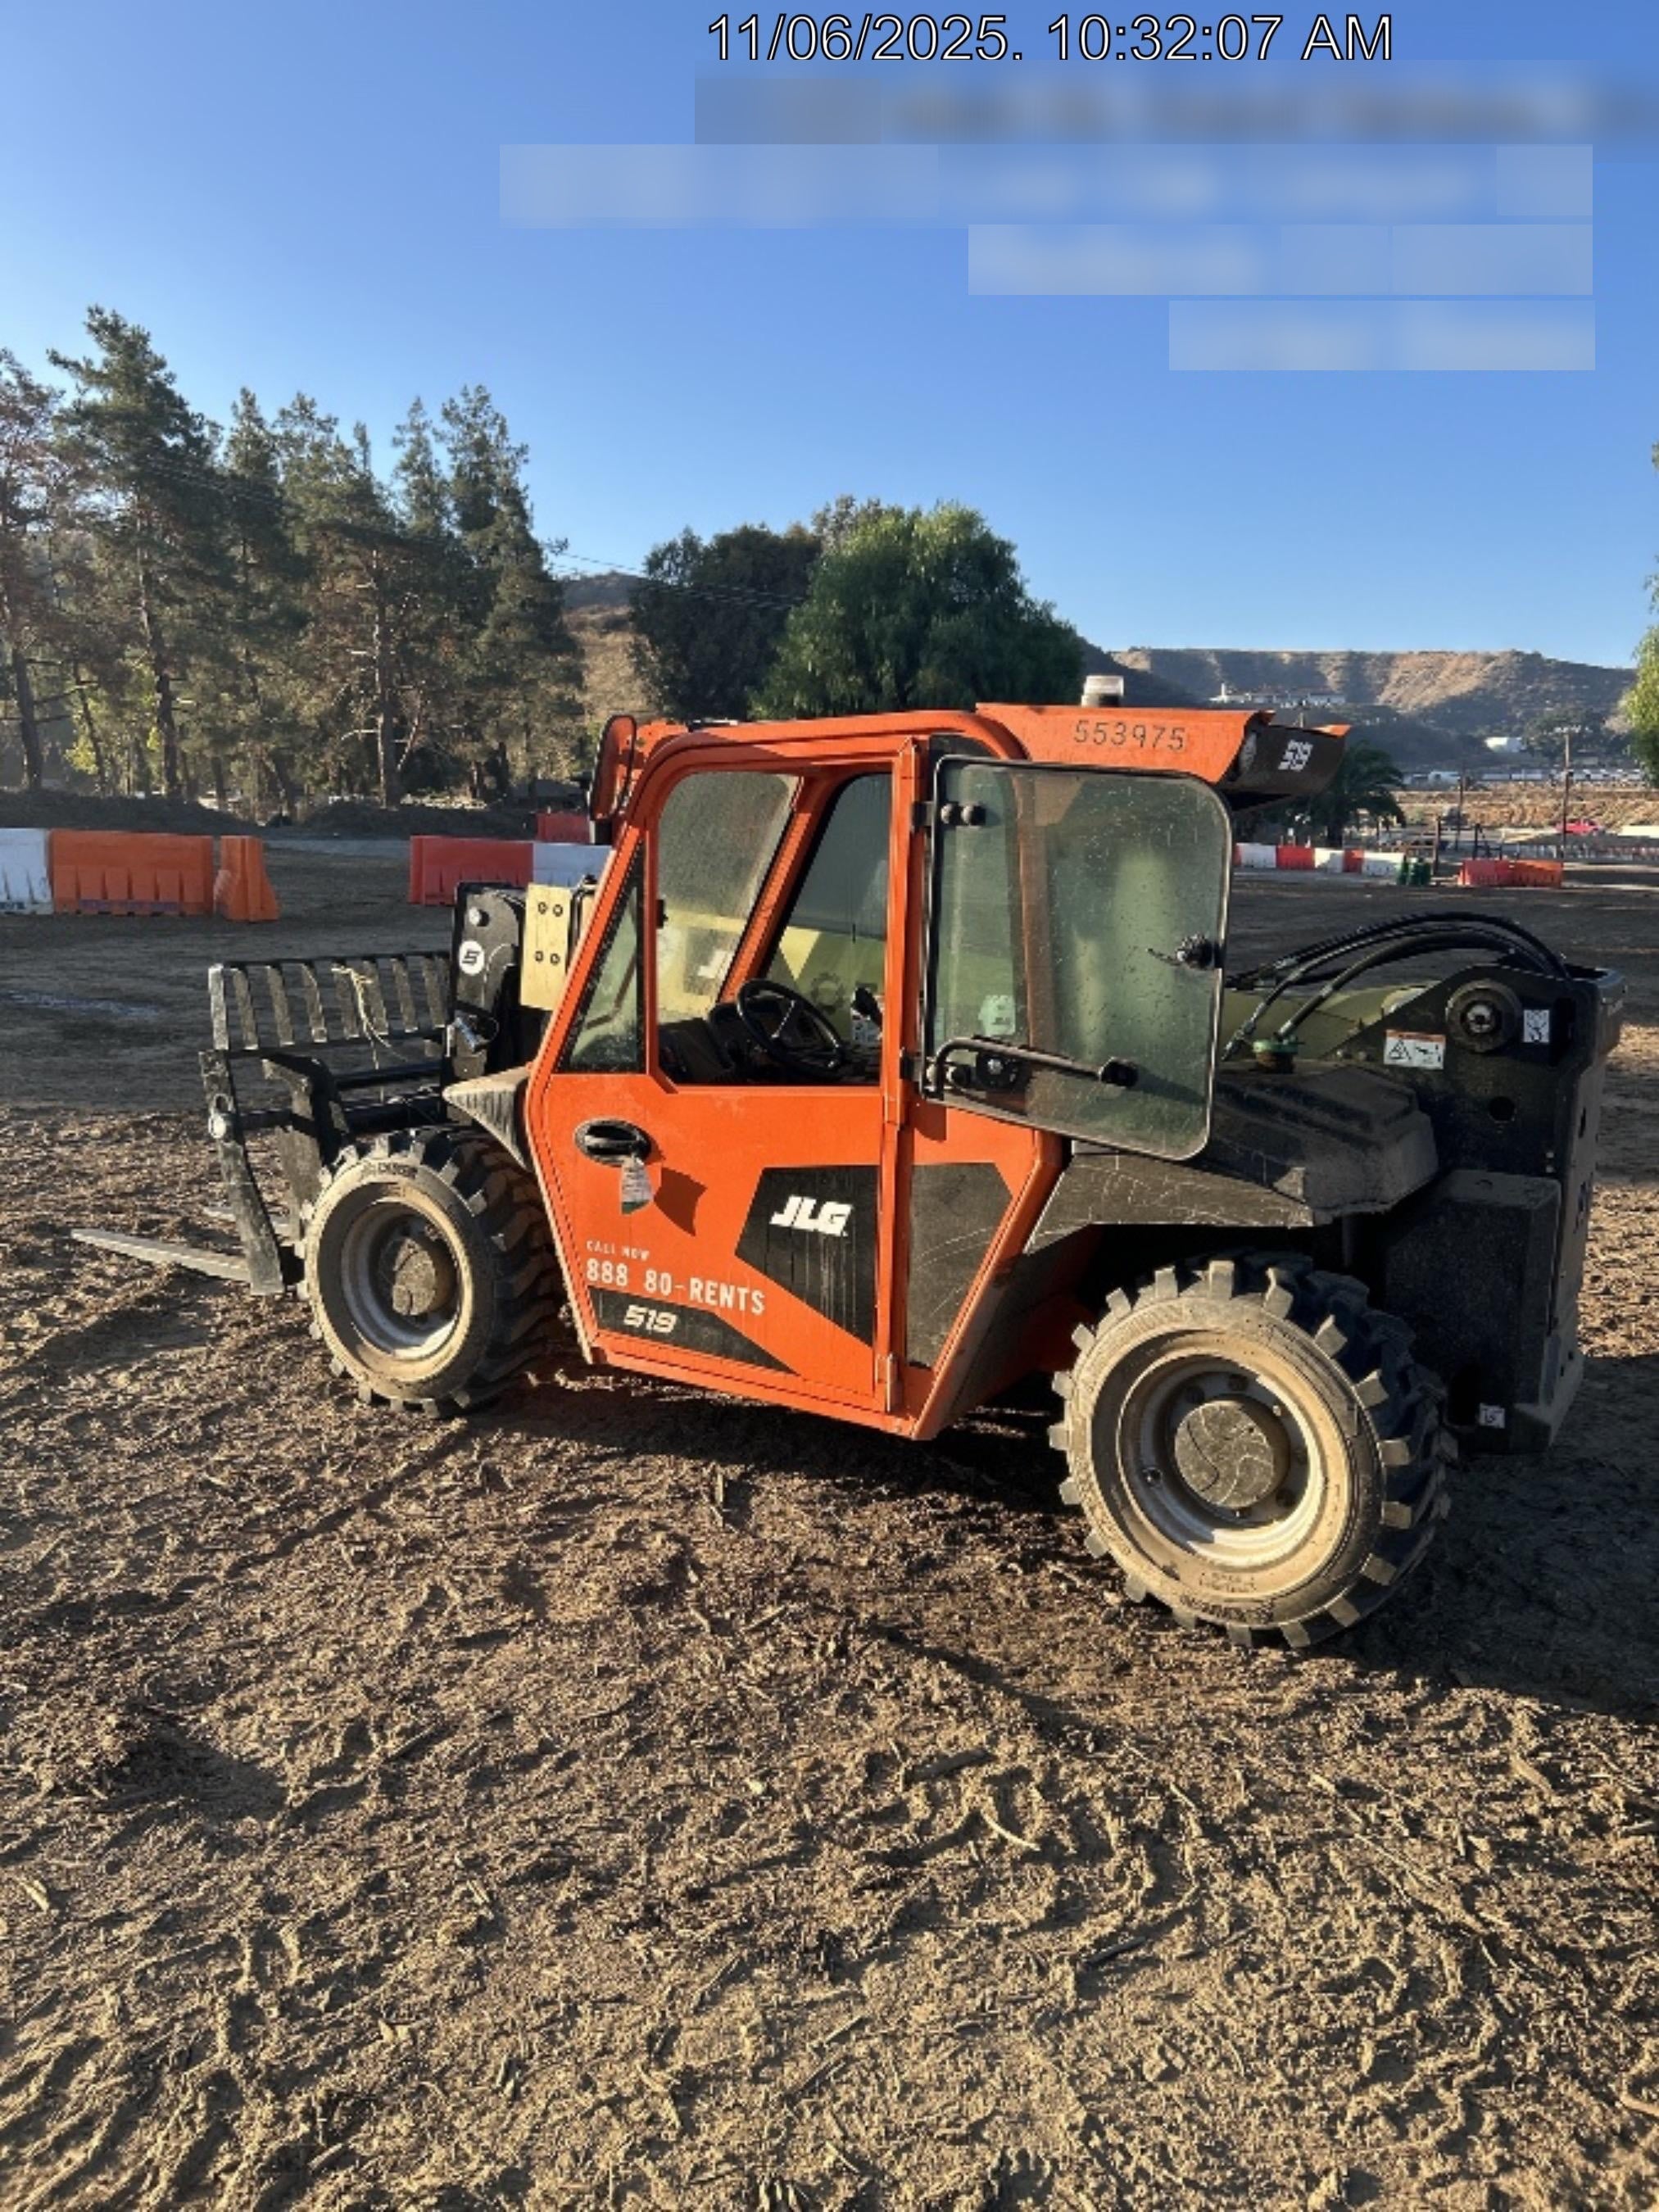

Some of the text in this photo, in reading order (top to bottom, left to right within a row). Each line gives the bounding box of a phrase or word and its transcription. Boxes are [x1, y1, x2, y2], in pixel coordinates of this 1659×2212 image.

[1074, 719, 1185, 750] 553975
[769, 1194, 854, 1237] JLG
[586, 1240, 650, 1262] CALL NOW
[586, 1258, 766, 1317] 888 80-RENTS
[623, 1303, 678, 1335] 519
